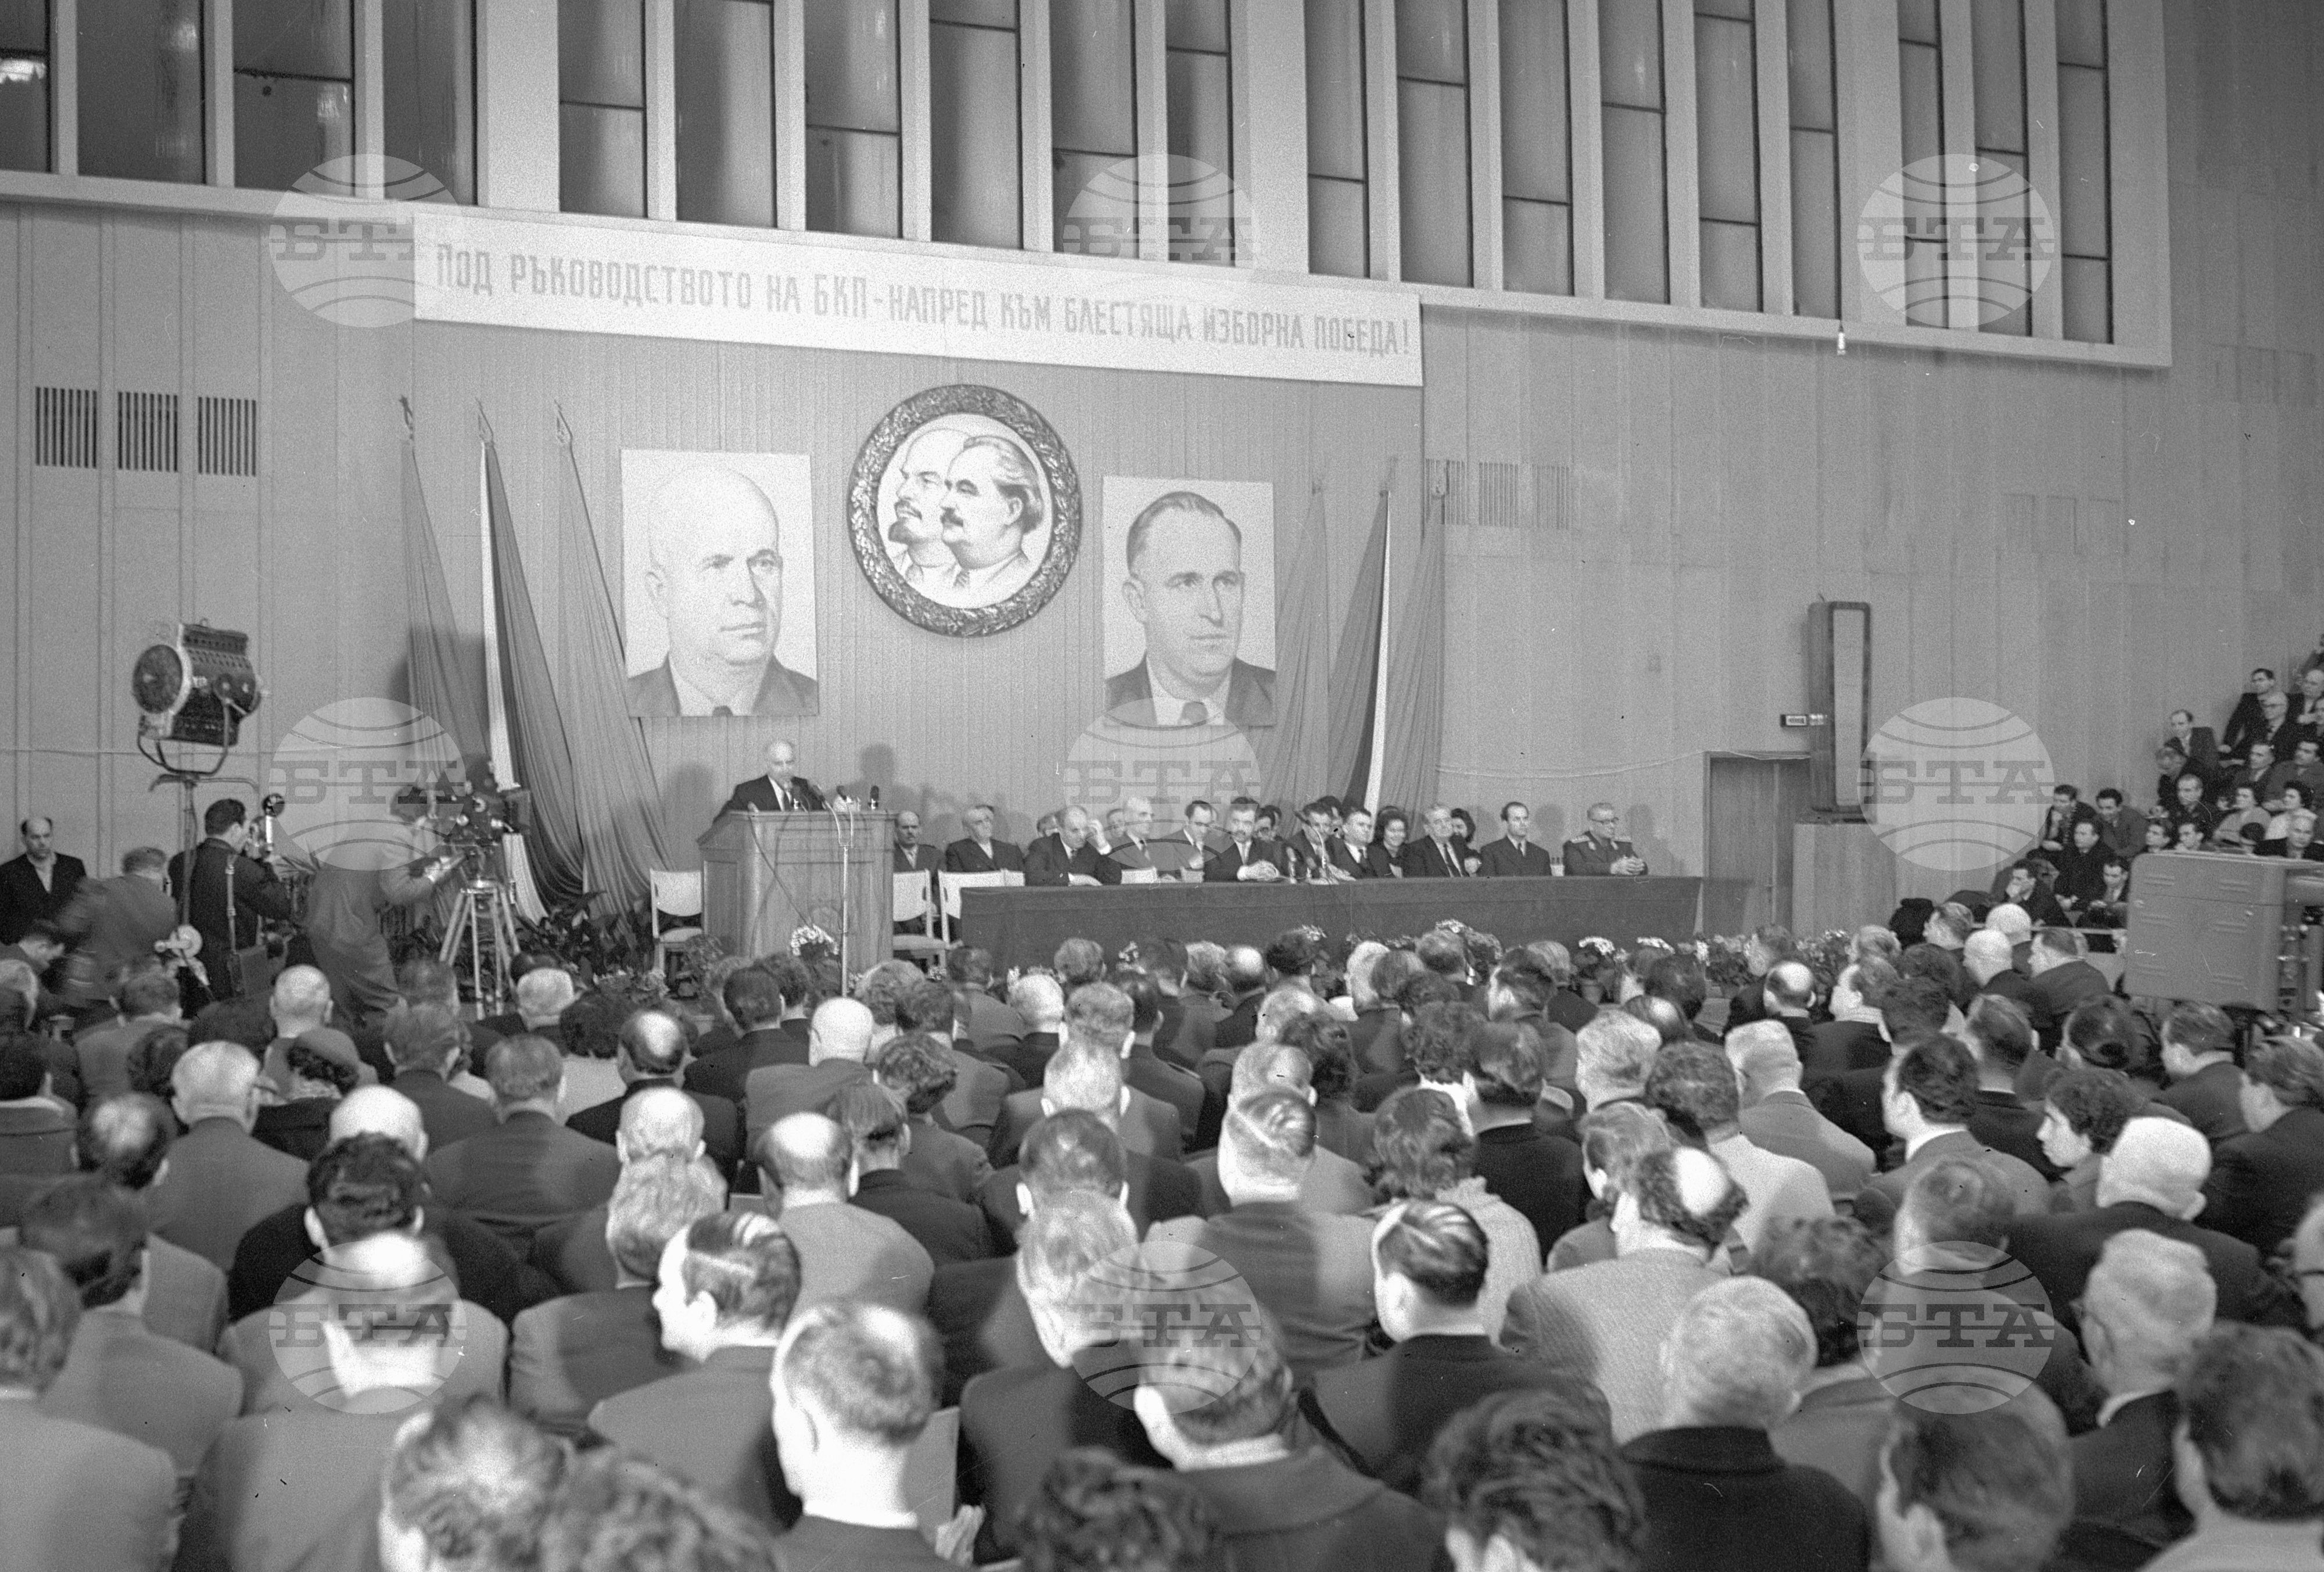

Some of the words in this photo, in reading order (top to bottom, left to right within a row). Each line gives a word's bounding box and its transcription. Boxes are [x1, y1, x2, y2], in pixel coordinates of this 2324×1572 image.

[437, 244, 493, 297] ПОД
[510, 253, 751, 309] РЪКОВОДСТВОТО
[766, 274, 801, 314] НА
[1000, 292, 1050, 331] КЪМ
[1064, 296, 1191, 344] БЛЕСТЯЩА
[1203, 307, 1305, 350] ИЗБОРНА
[1314, 316, 1408, 358] ПОБЕДА!
